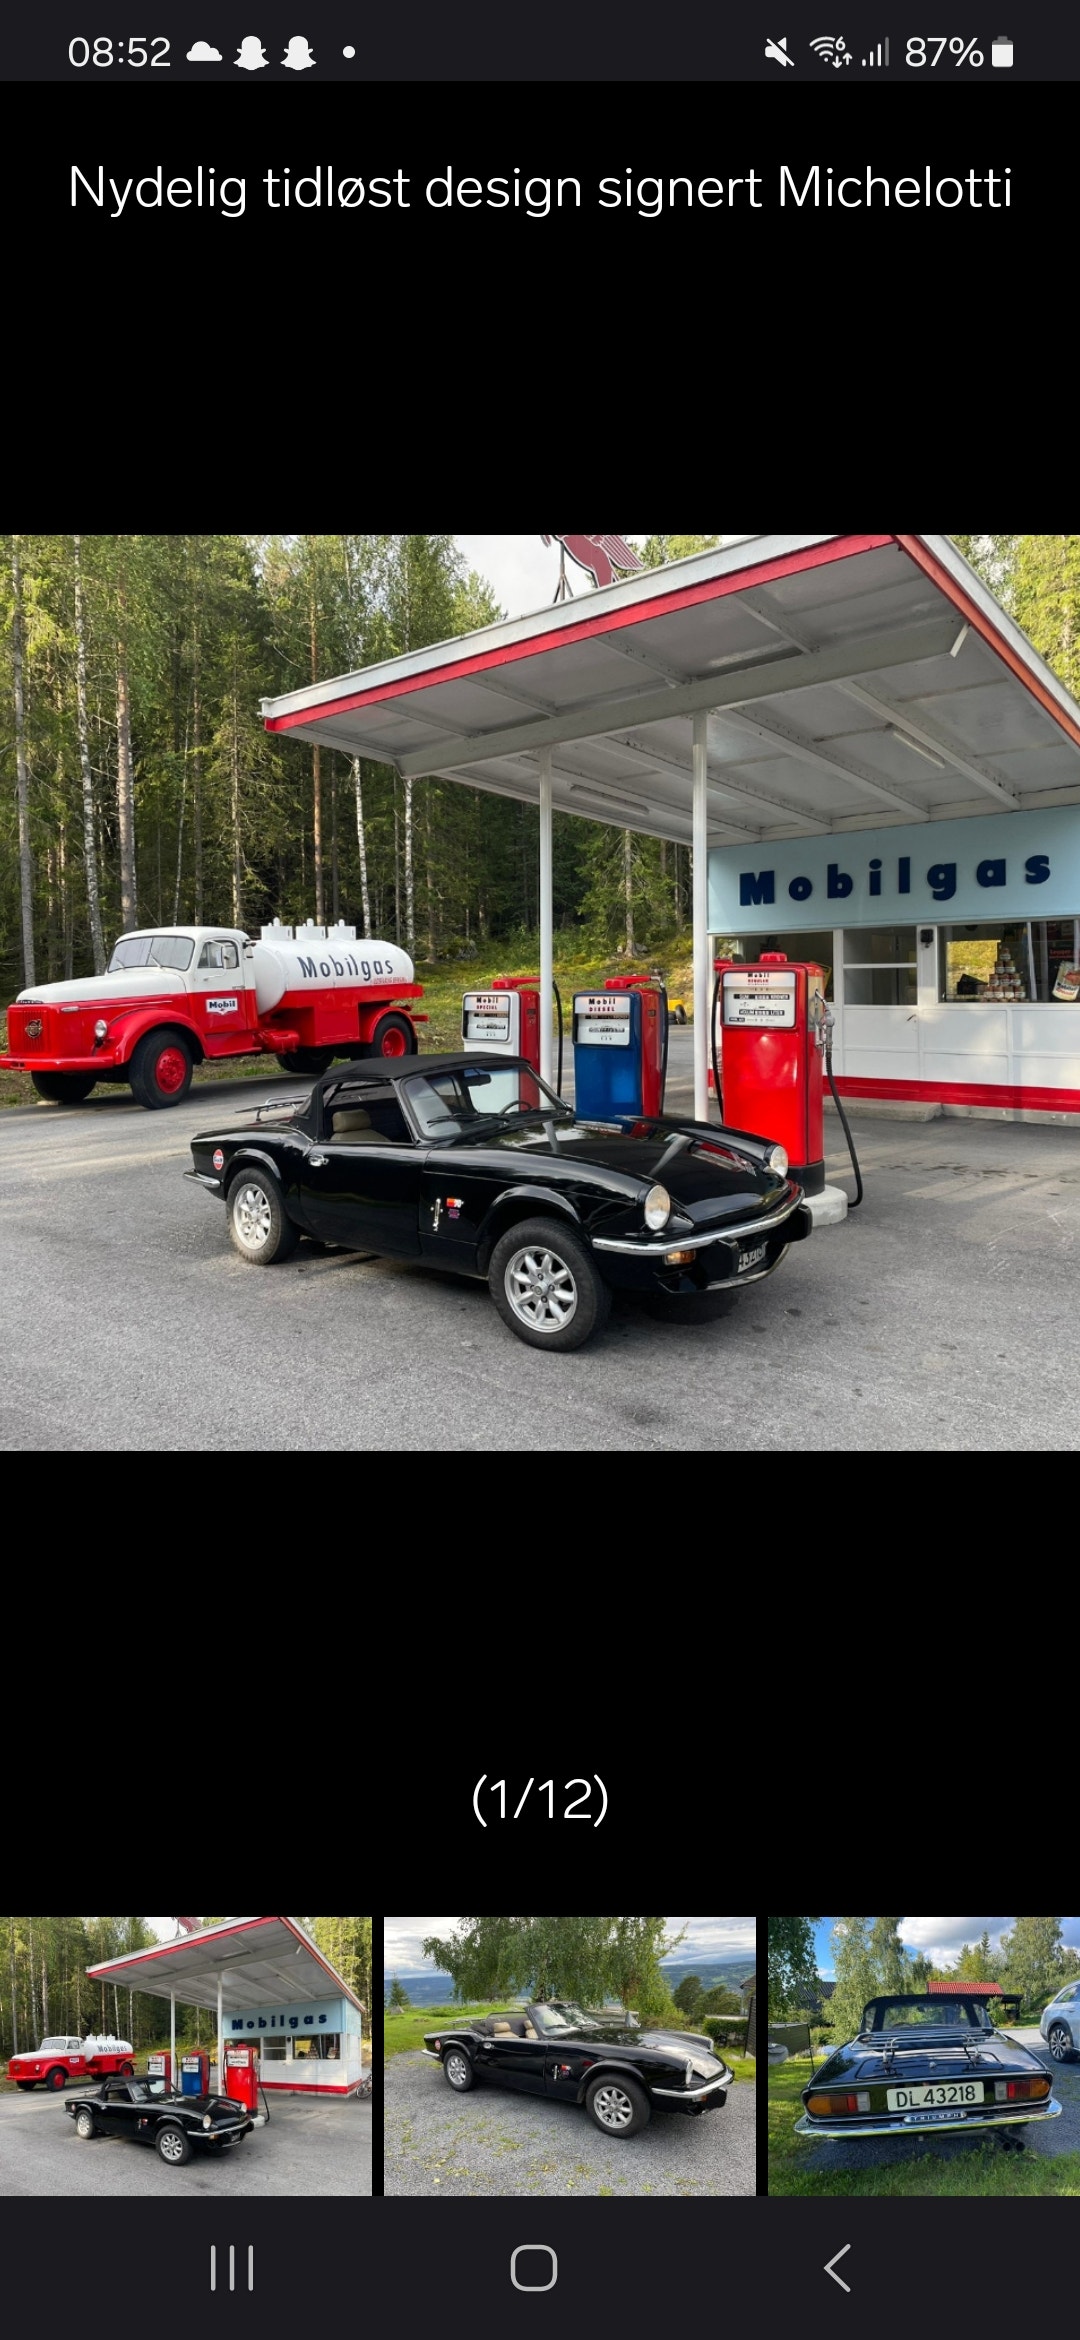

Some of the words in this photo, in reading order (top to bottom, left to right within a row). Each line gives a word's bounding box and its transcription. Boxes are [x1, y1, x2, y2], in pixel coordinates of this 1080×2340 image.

[739, 855, 1051, 906] Mobilgas
[297, 954, 394, 981] Mobilgas
[232, 2014, 328, 2030] Mobilgas
[896, 2090, 920, 2108] DL
[923, 2085, 976, 2104] 43218
